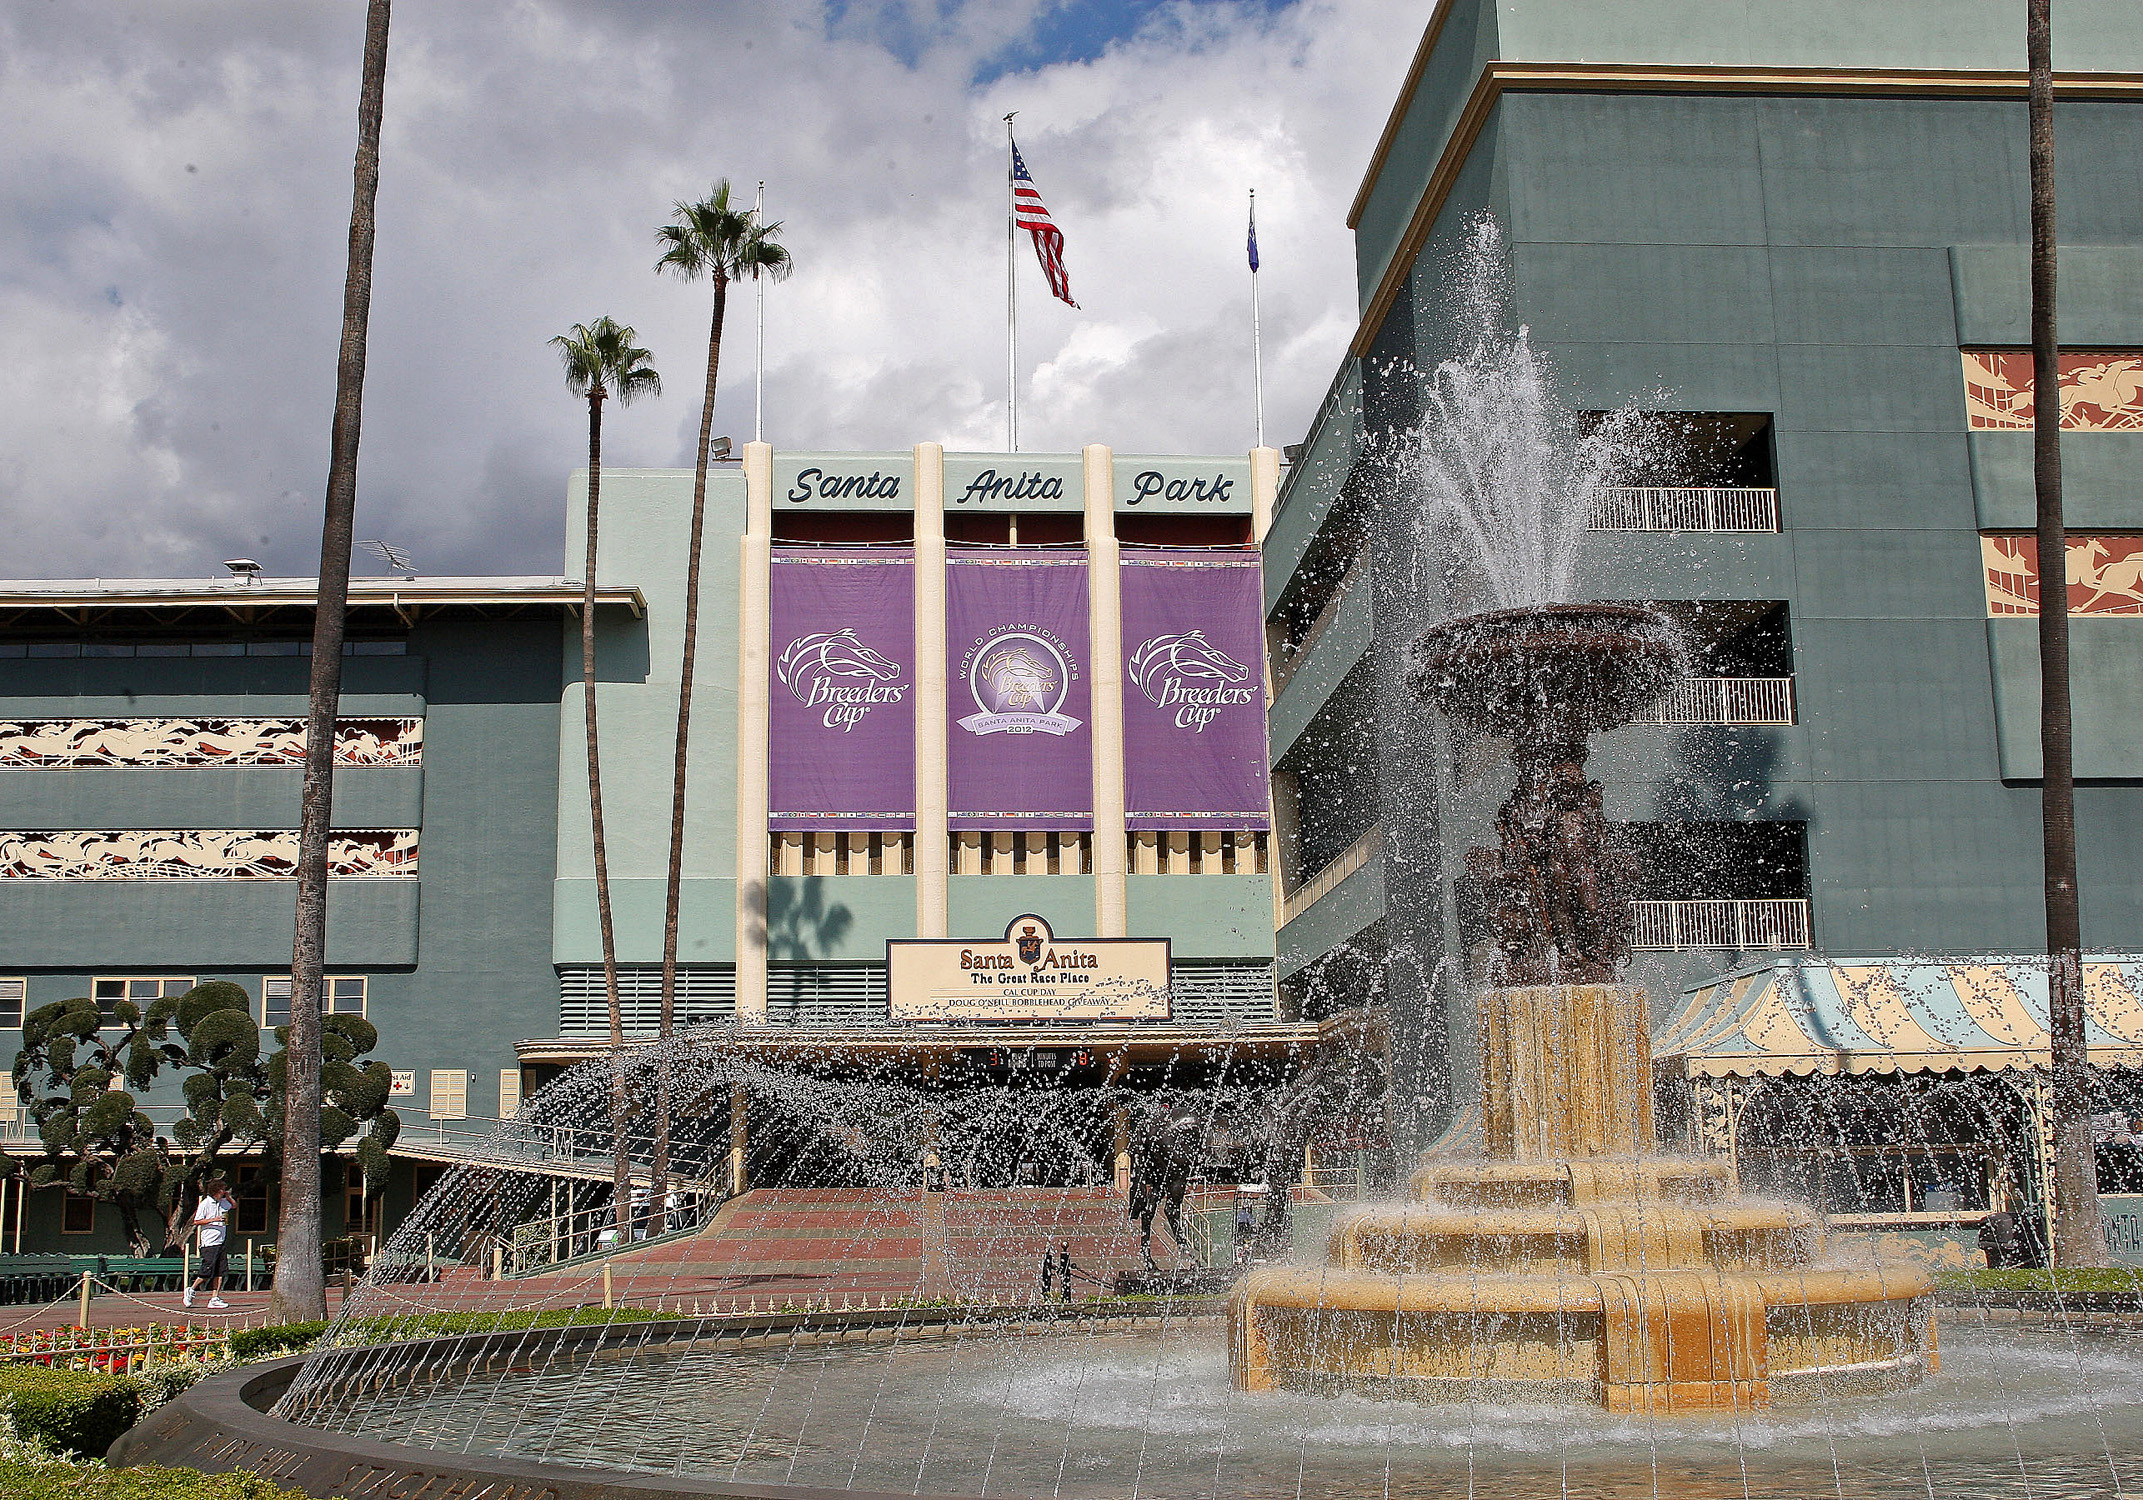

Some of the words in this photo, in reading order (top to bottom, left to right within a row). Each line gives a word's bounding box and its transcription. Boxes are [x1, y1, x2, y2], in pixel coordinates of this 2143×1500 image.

[788, 467, 901, 503] Santa
[957, 469, 1064, 504] Anita
[1127, 471, 1234, 506] Park
[959, 637, 984, 680] WORLD
[988, 623, 1080, 681] CHAMPIONSHIPS
[977, 718, 1008, 729] SANTA
[1039, 718, 1063, 729] PARK
[1008, 725, 1033, 734] 2012
[960, 948, 1014, 970] Santa
[1033, 947, 1098, 972] Anita
[970, 972, 993, 985] The
[997, 972, 1027, 985] Great
[1030, 972, 1057, 985] Race
[1059, 972, 1090, 985] Place
[1003, 988, 1019, 997] CAL
[1020, 988, 1038, 997] CUP
[1040, 988, 1057, 997] DAY
[949, 999, 976, 1007] DOUG
[978, 998, 1010, 1007] O'NEILL
[1012, 998, 1066, 1008] BOBBLEHEAD
